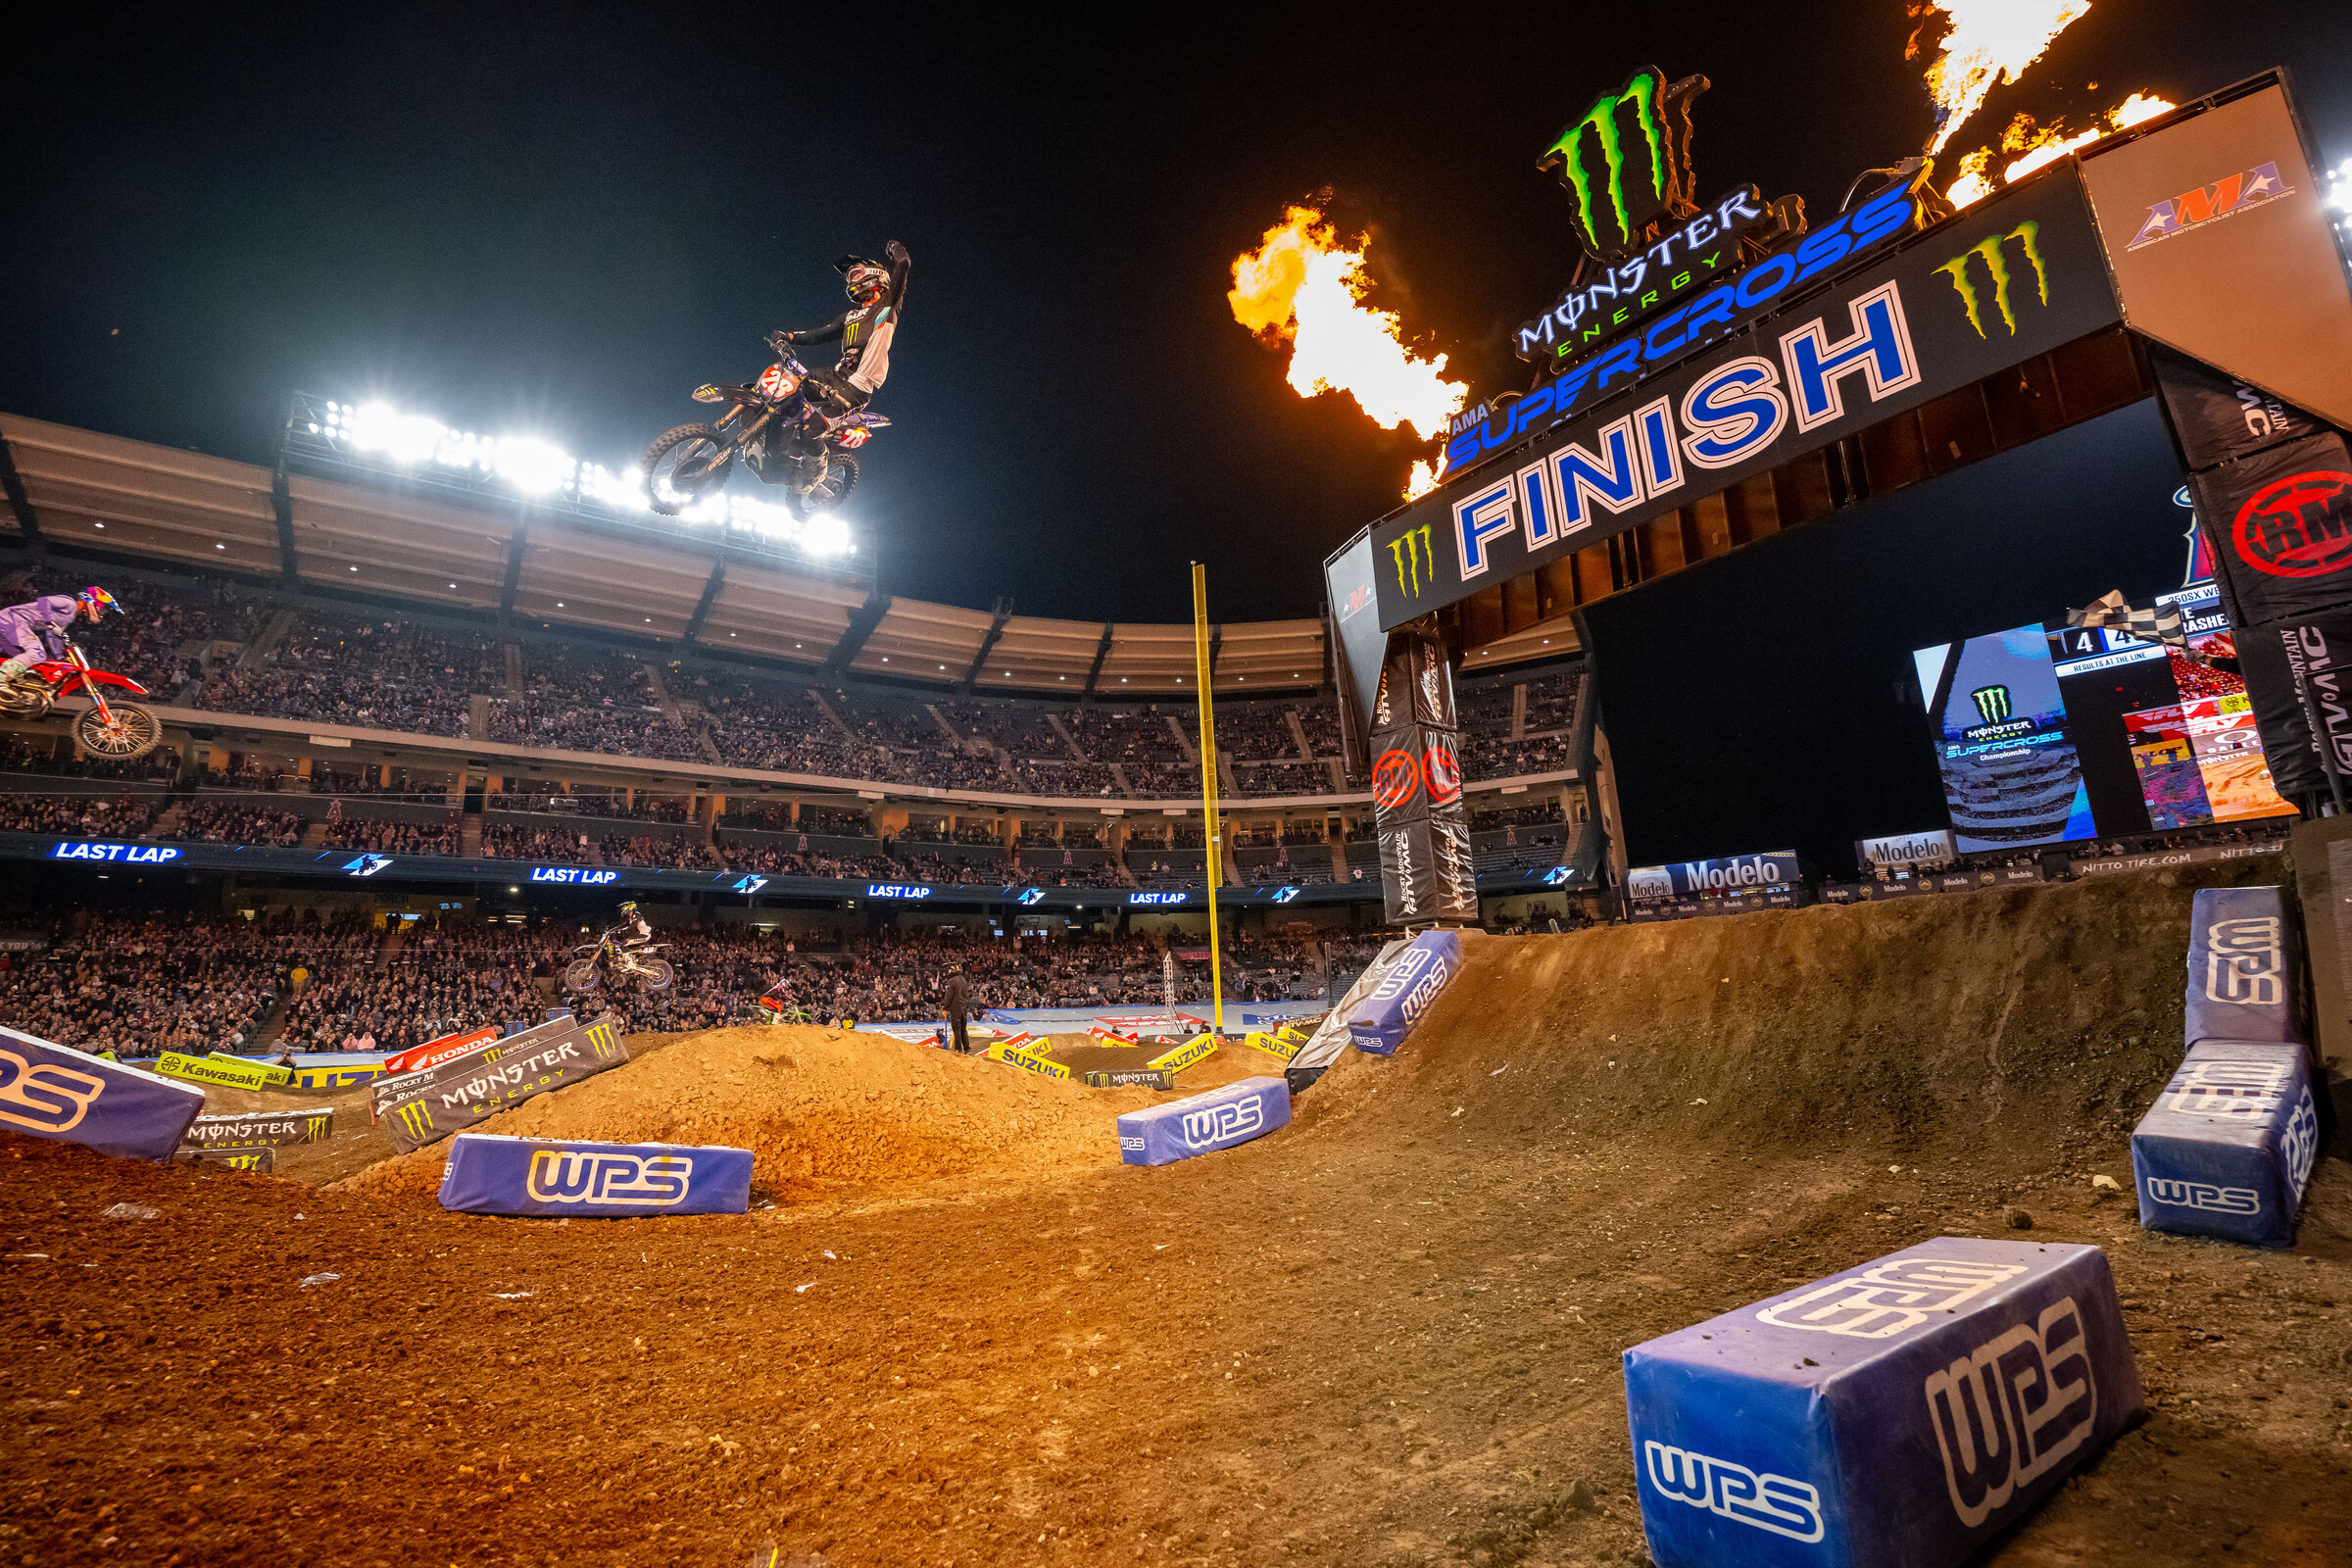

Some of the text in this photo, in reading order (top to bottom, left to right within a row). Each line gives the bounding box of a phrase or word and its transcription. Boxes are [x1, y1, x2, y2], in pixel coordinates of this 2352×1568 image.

[2125, 161, 2295, 248] AMA
[2127, 189, 2295, 253] AMERICAN MOTORCYCLIST ASSOCIATION
[1557, 251, 1721, 358] ENERGY
[1445, 180, 1912, 474] SUPERCROSS
[760, 369, 794, 396] 28
[1451, 403, 1489, 436] AMA
[1451, 279, 1922, 582] FINISH
[840, 428, 866, 449] 28
[2077, 632, 2093, 652] 4
[2074, 652, 2146, 672] RESULTS AT THE LINE
[1967, 720, 2033, 739] MONSTER
[1979, 730, 2023, 742] ENERGY
[1945, 730, 2064, 759] SUPERCROSS
[1980, 748, 2032, 761] Championship
[56, 843, 177, 862] LAST LAP
[1875, 838, 1940, 862] Modelo
[2082, 853, 2191, 874] NITTO TIRE.COM
[2220, 846, 2263, 859] NITTO
[532, 867, 616, 884] LAST LAP
[1396, 832, 1408, 903] ROCKY MOUNTAIN
[1686, 856, 1780, 892] Modelo
[2007, 870, 2034, 880] Modelo
[868, 885, 930, 899] LAST LAP
[1631, 881, 1671, 898] Modelo
[1827, 890, 1849, 899] Modelo
[1884, 884, 1906, 893] Modelo
[1943, 877, 1968, 887] Modelo
[1129, 893, 1186, 904] LAST LAP
[2206, 916, 2282, 1005] WPS
[1370, 948, 1432, 1001] WPS
[1401, 956, 1447, 1025] WPS
[430, 1036, 495, 1065] HONDA
[1163, 1039, 1213, 1069] SUZUKI
[1259, 1037, 1297, 1059] SUZU
[1354, 1035, 1383, 1048] WPS
[182, 1061, 263, 1088] Kawasaki
[1002, 1049, 1066, 1079] SUZUKI
[392, 1077, 422, 1091] ROCKY
[471, 1067, 565, 1114] ENERGY
[1183, 1095, 1263, 1150] WPS
[204, 1138, 280, 1149] ENERGY
[1119, 1136, 1145, 1151] WPS
[526, 1151, 692, 1206] WPS
[2147, 1176, 2260, 1215] WPS
[1755, 1258, 2030, 1339] WPS
[1925, 1296, 2097, 1528] WPS
[1643, 1440, 1825, 1544] WPS
